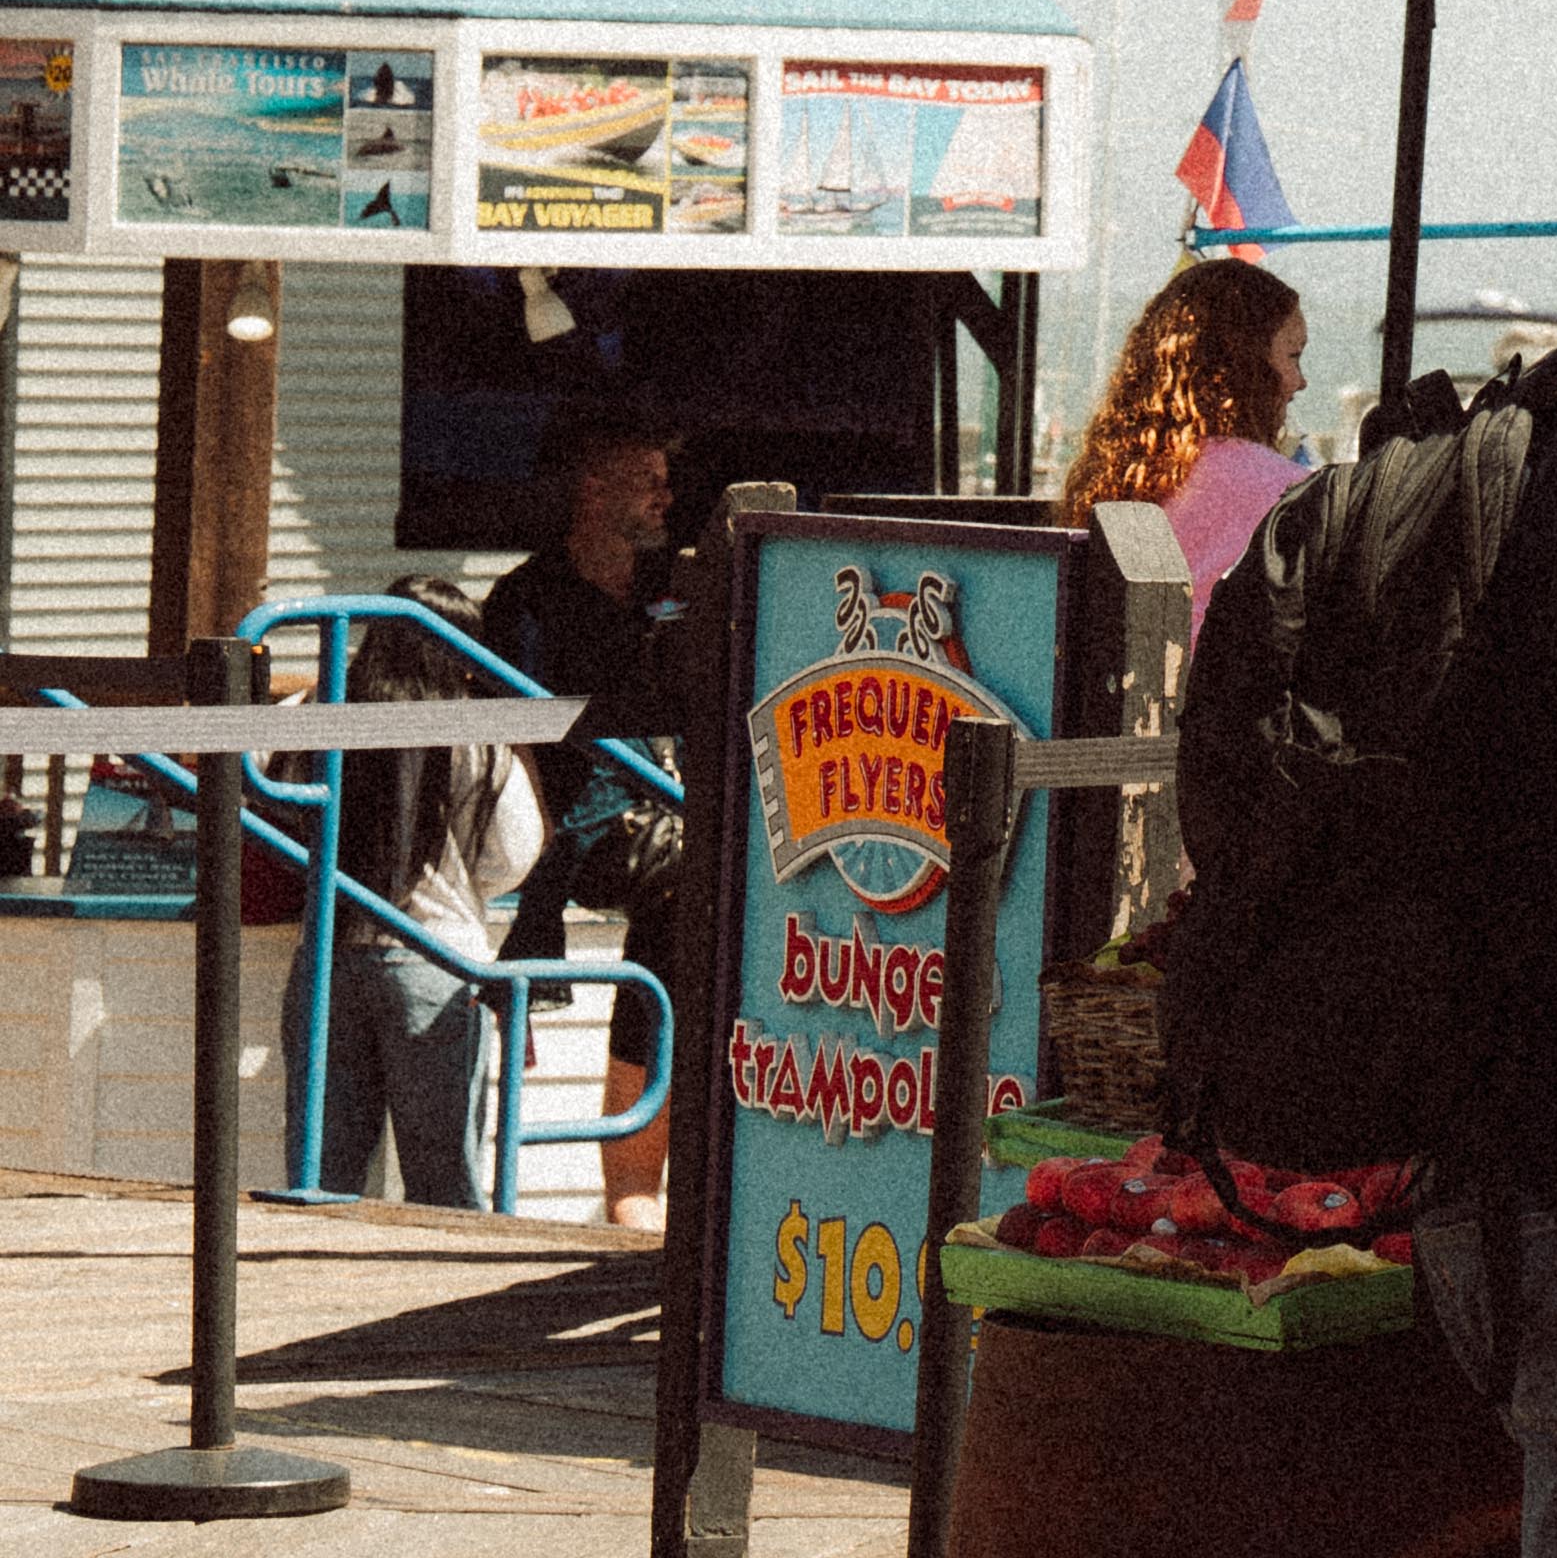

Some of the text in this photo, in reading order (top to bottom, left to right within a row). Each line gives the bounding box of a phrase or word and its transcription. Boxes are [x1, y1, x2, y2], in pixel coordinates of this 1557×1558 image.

[245, 70, 326, 98] Tours
[784, 70, 844, 91] SAIL
[888, 73, 942, 97] BAY
[944, 76, 1034, 99] TODAY
[532, 203, 654, 228] VOYAGER
[790, 676, 962, 759] FREQUEN
[820, 752, 946, 831] FLYERS
[773, 1198, 929, 1355] $10.
